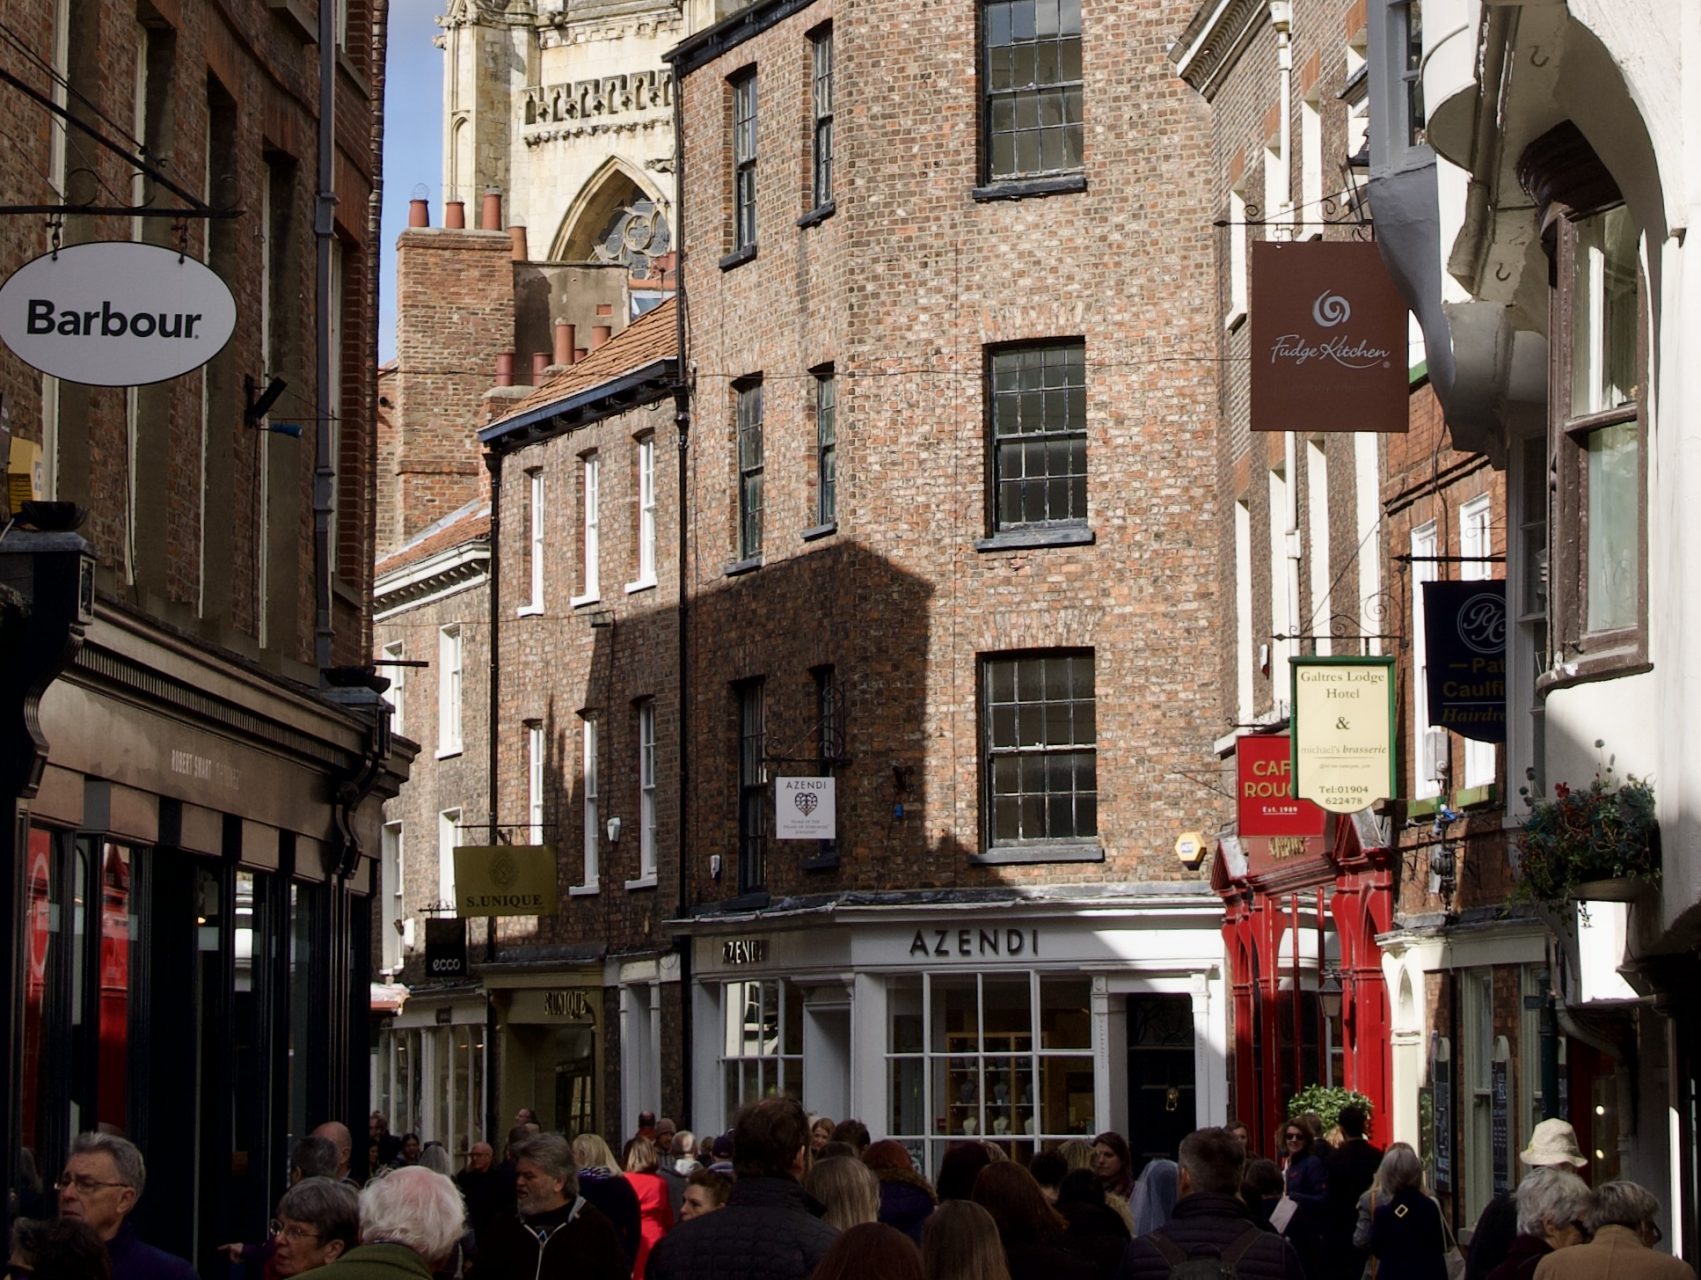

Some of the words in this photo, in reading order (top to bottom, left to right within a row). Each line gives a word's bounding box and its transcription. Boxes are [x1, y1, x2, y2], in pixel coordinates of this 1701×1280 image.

[27, 299, 202, 339] Barbour
[1271, 334, 1319, 365] Fudge
[1319, 335, 1390, 368] Kitchen
[1300, 671, 1343, 683] Galtres
[1347, 671, 1384, 684] Lodge
[1326, 688, 1360, 699] Hotel
[1335, 716, 1350, 730] &
[1342, 744, 1387, 754] brasserie
[786, 781, 826, 790] AZENDI
[1319, 785, 1369, 794] Tel:01904
[466, 894, 543, 909] S.UNIQUE
[910, 929, 1038, 957] AZENDI
[433, 959, 460, 971] ecco
